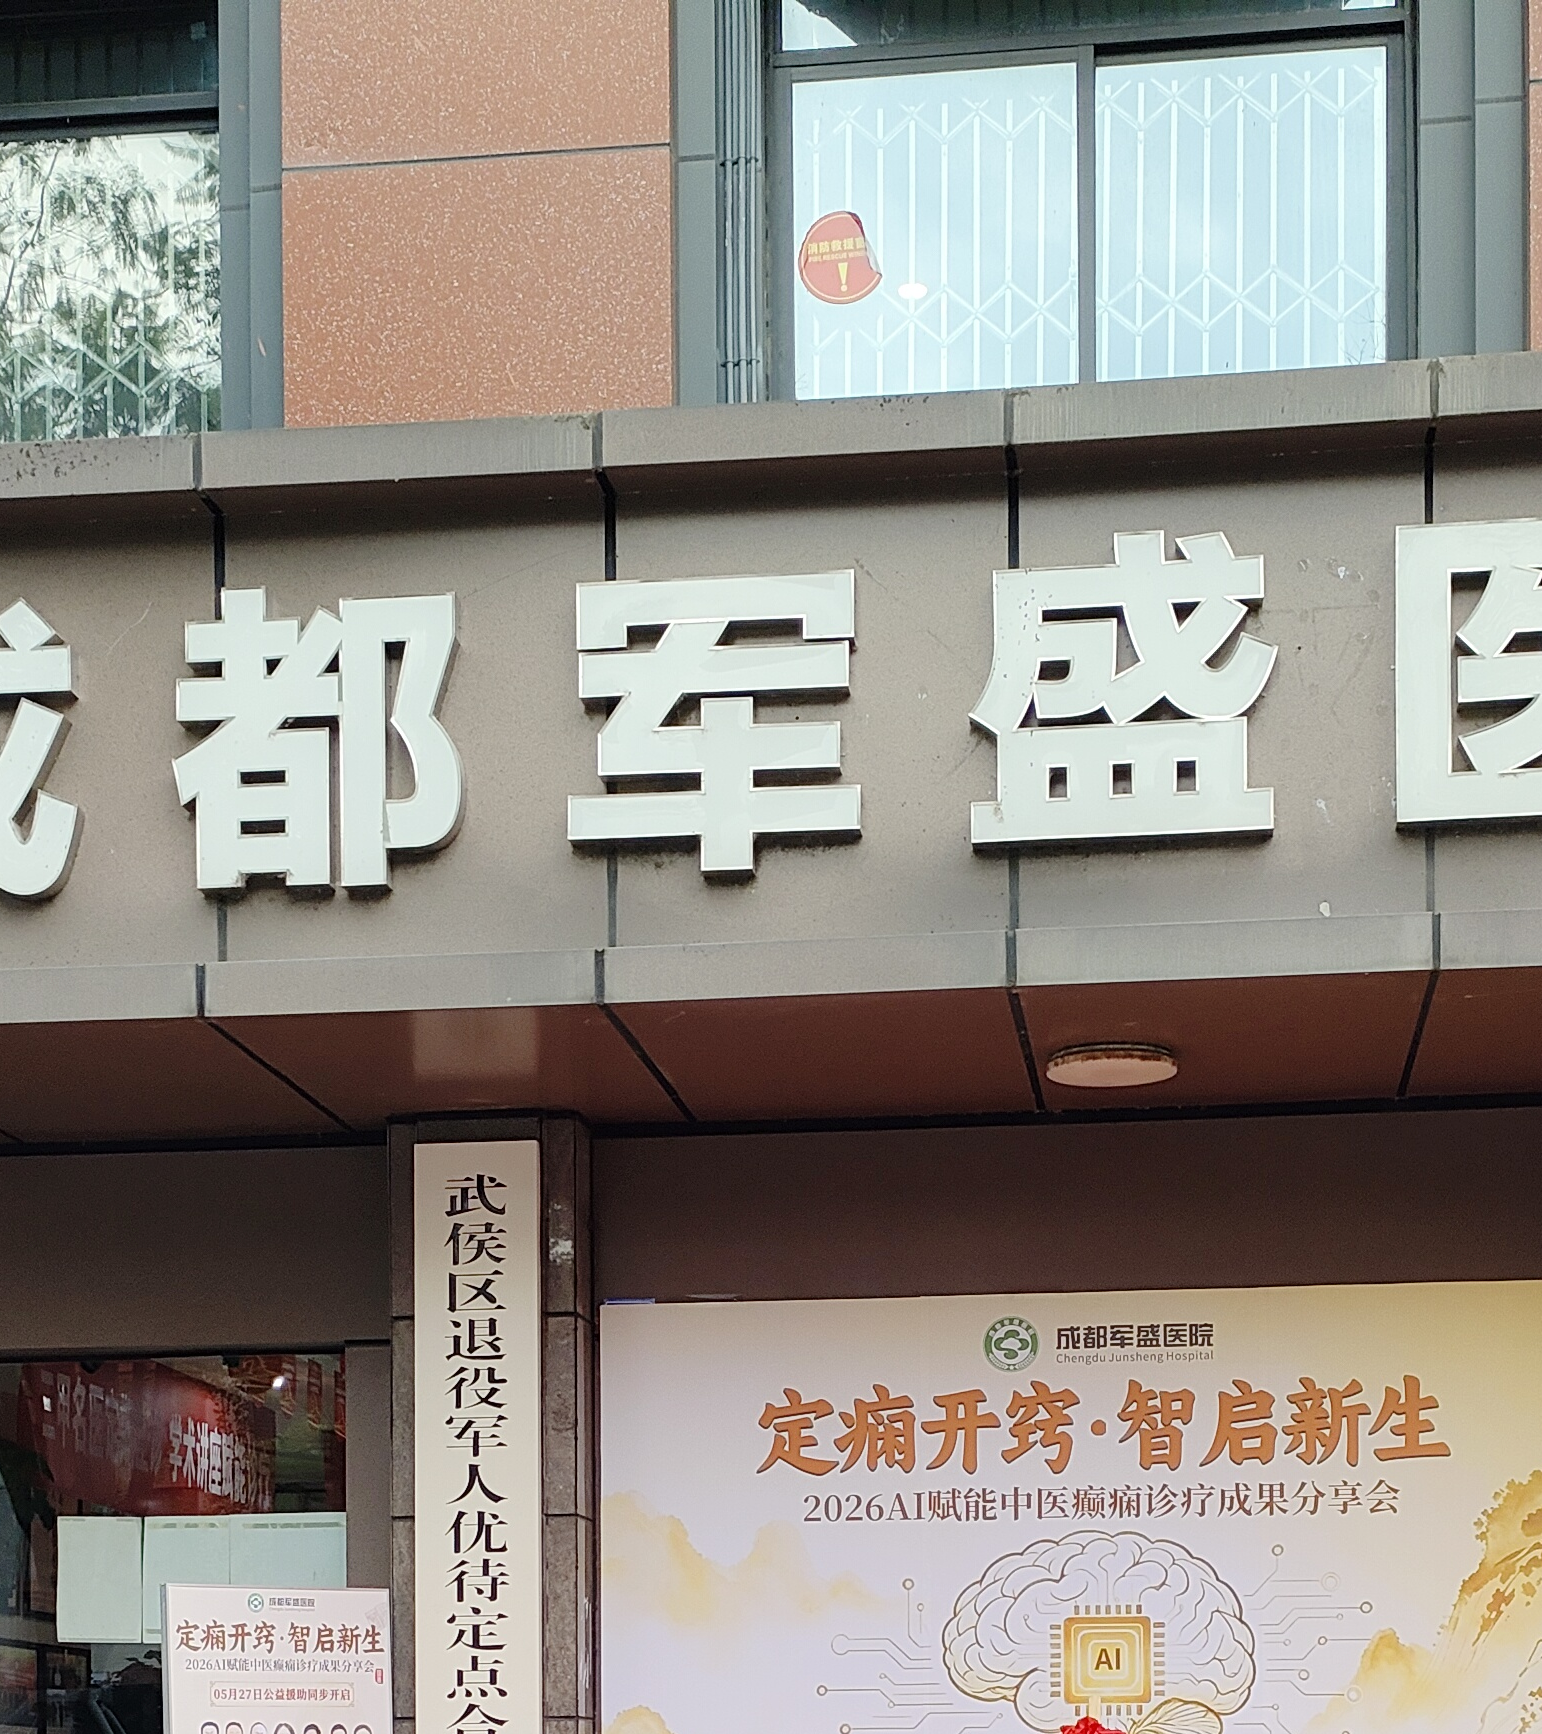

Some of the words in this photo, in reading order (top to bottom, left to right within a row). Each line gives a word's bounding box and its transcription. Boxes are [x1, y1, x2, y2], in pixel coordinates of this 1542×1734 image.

[1056, 1323, 1214, 1349] 成都军盛医院
[1056, 1353, 1106, 1365] Chengdu
[1109, 1352, 1164, 1365] Junsheng
[1166, 1350, 1214, 1363] Hospital
[756, 1375, 1451, 1477] 定痫开窍·智启新生
[803, 1481, 1400, 1524] 2026AI赋能中医癫痫诊疗成果分享会
[175, 1619, 385, 1654] 定痫开窍·智启新生
[185, 1658, 374, 1673] 2026AI赋能中医癫痫诊疗成果分享会
[1094, 1648, 1120, 1670] AI
[213, 1688, 351, 1701] 05月27日公益援助同步开启
